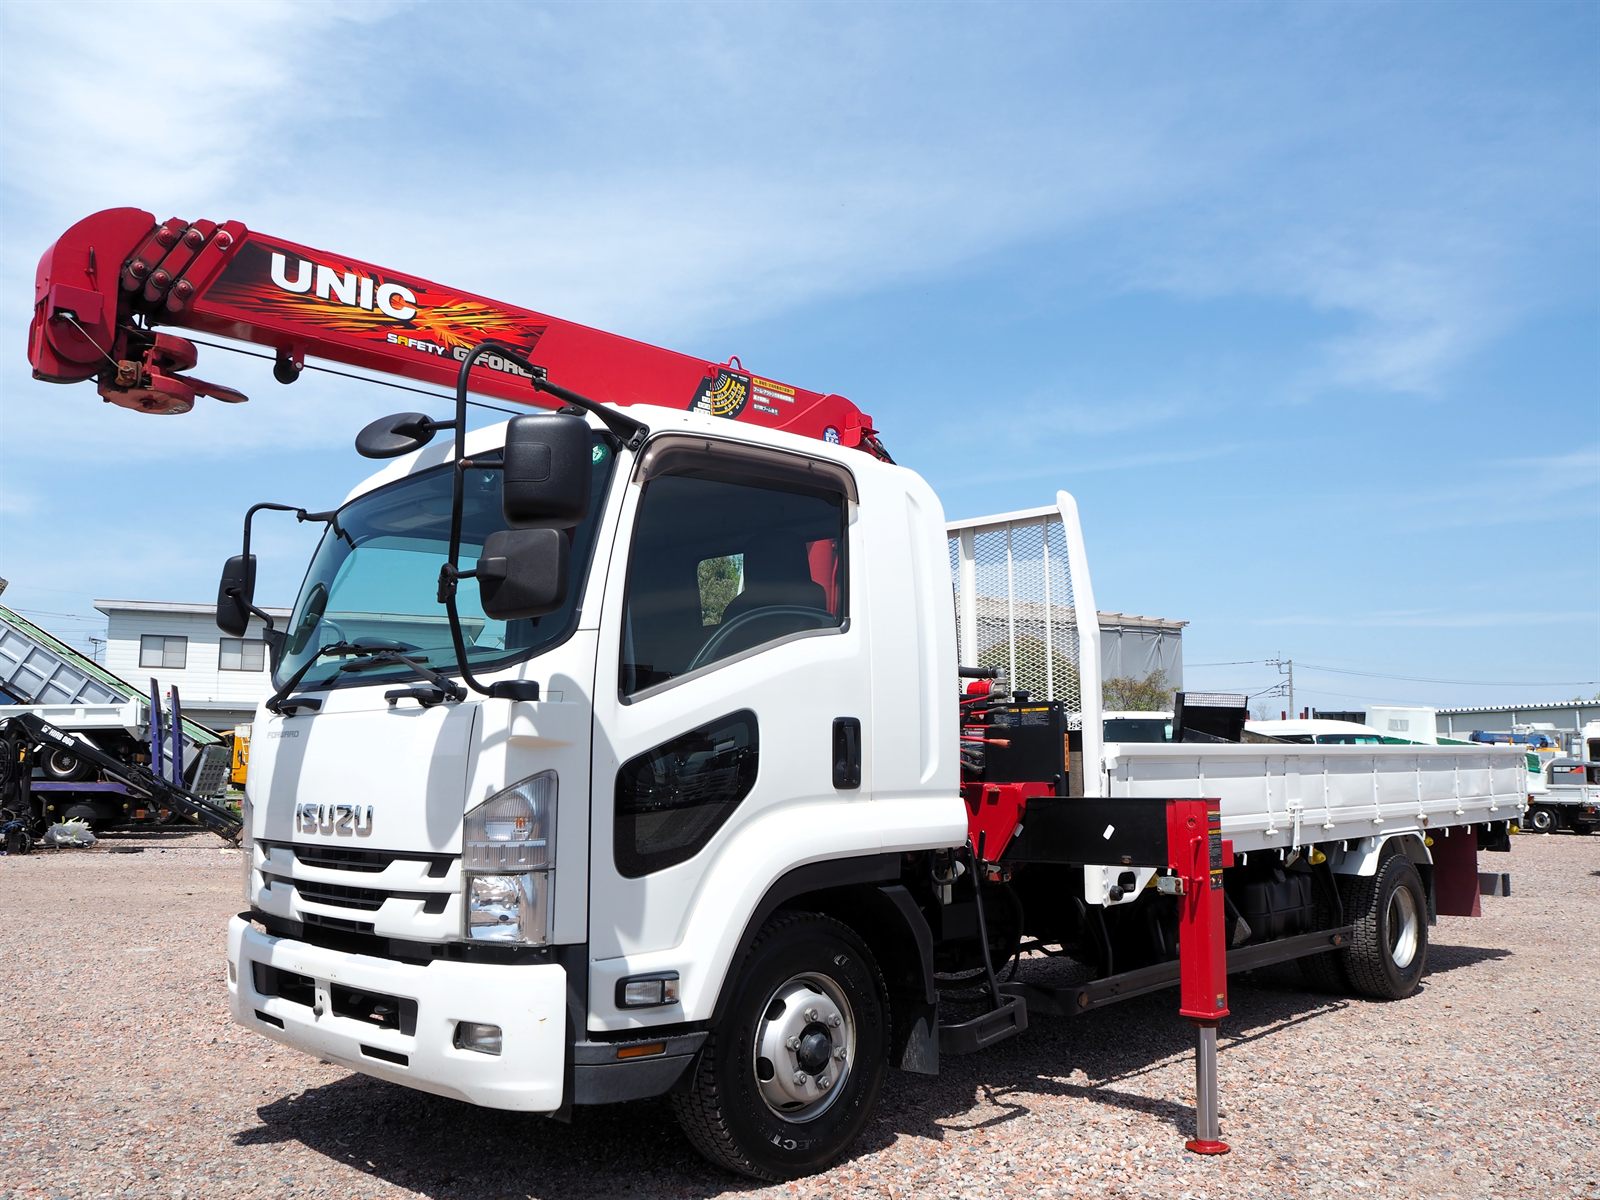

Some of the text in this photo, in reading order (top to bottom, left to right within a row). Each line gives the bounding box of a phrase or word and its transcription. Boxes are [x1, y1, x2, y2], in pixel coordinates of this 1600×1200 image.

[270, 252, 417, 320] UNIC
[387, 333, 445, 355] SAFETY
[296, 803, 373, 837] ISUZU
